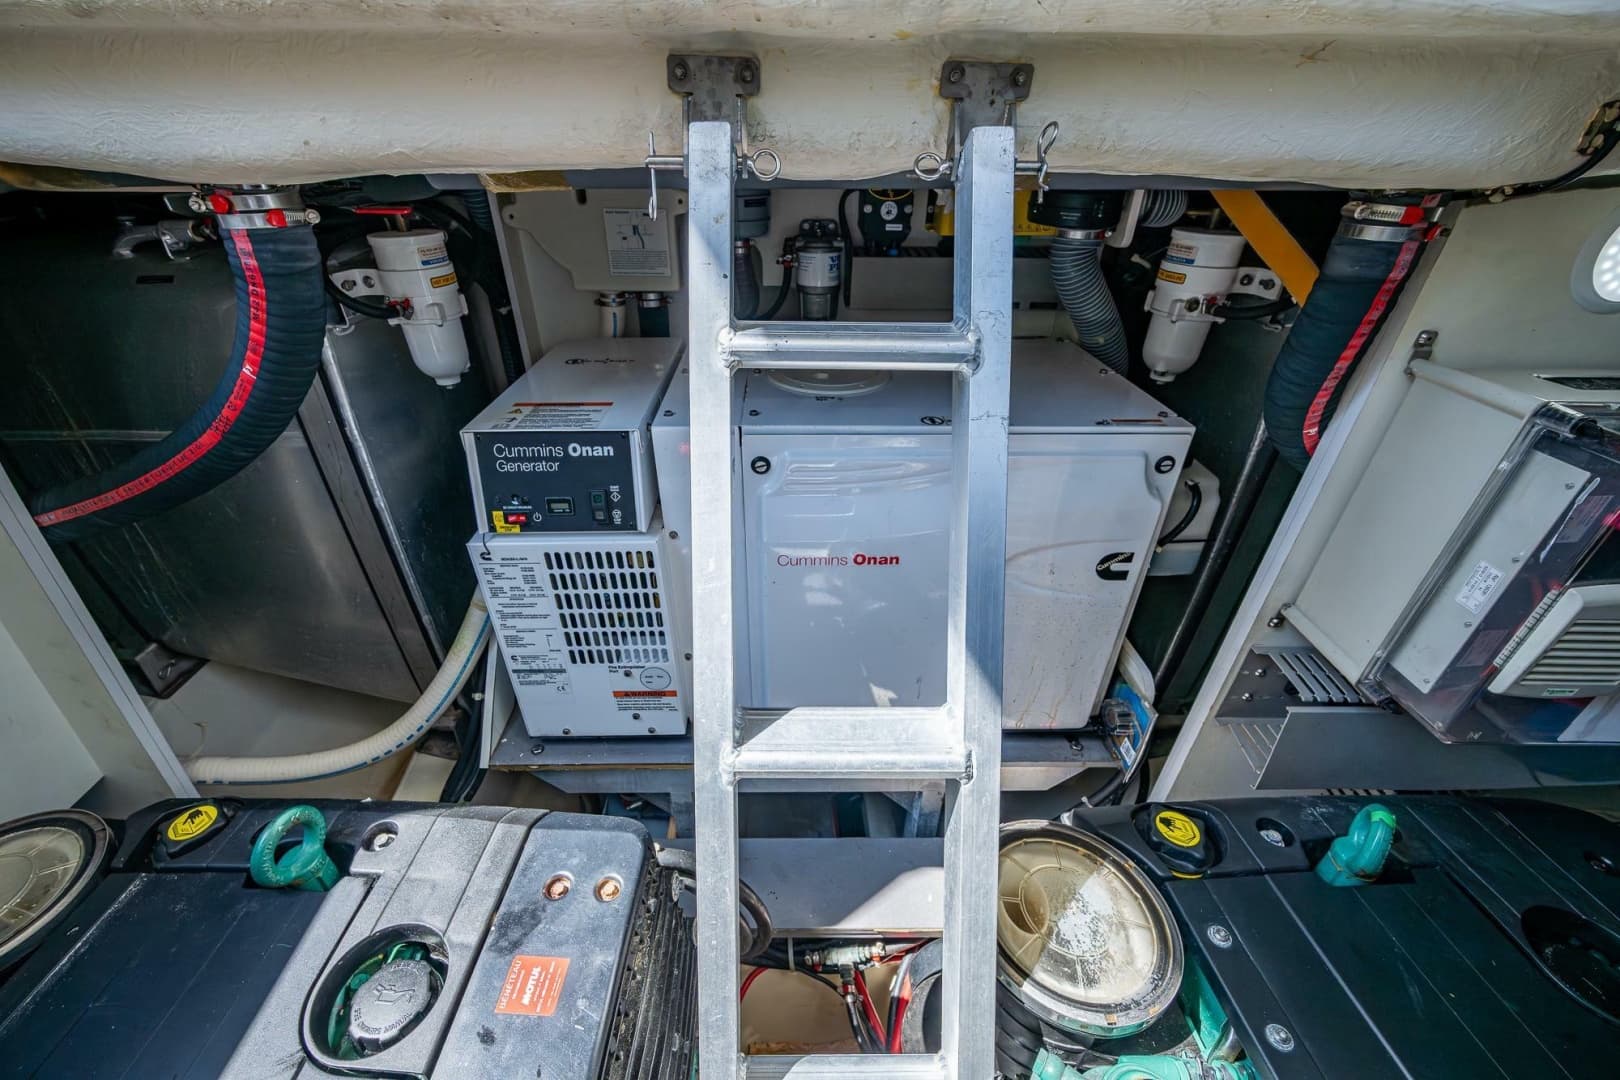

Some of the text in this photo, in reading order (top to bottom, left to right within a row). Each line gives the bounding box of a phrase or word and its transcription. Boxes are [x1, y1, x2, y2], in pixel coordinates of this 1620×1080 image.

[493, 443, 614, 457] Cummins Onan
[496, 459, 560, 472] Generator
[776, 553, 900, 567] Cummins Onan
